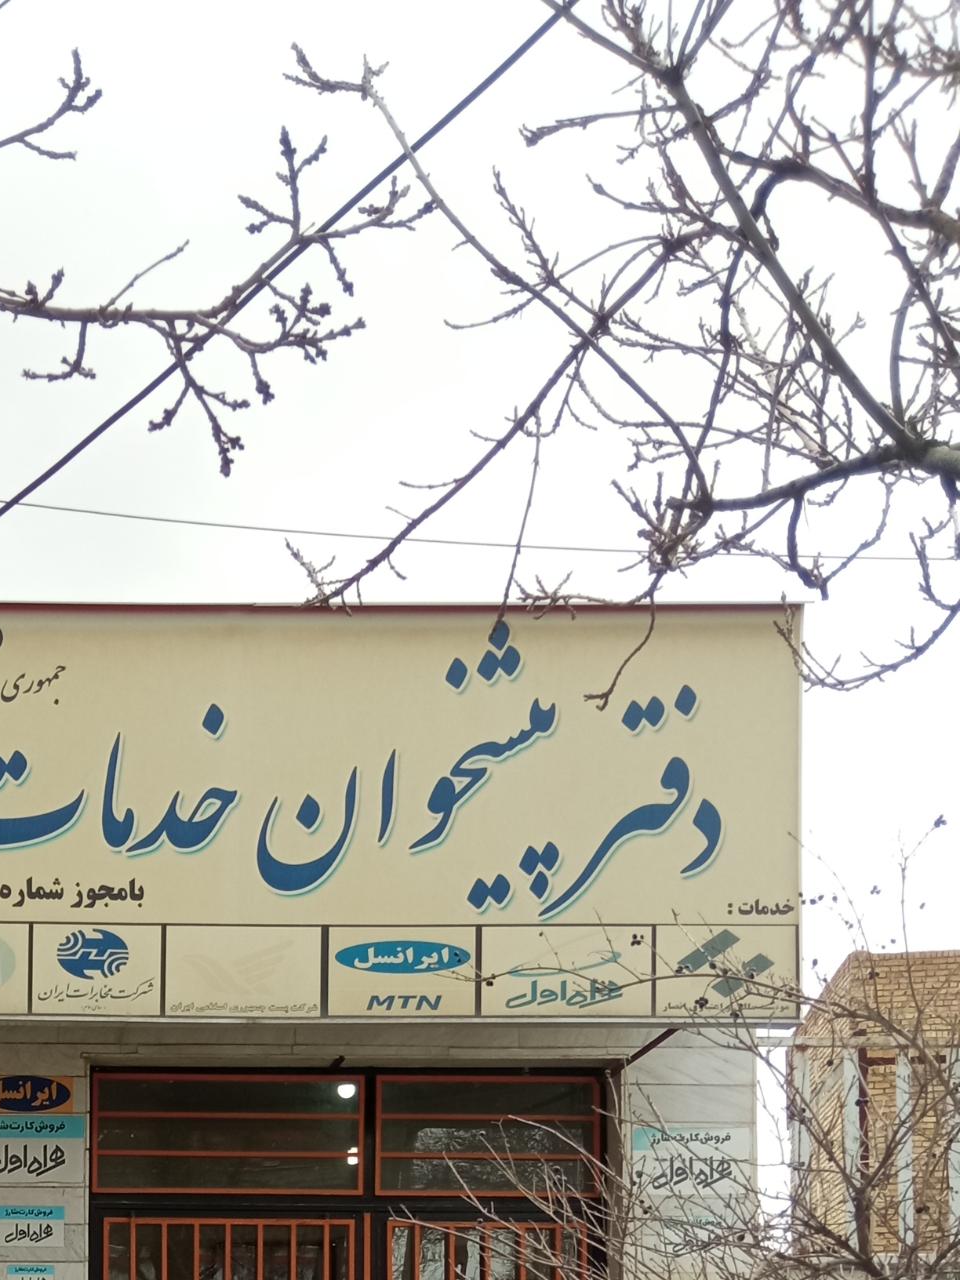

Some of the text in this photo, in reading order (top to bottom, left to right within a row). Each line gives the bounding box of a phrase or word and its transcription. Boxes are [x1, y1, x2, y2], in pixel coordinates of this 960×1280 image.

[0, 665, 66, 705] جمهوری
[256, 622, 561, 913] پیشخوان
[537, 684, 724, 921] دفتر
[737, 899, 795, 916] خدمات
[353, 945, 450, 970] ایرانسل
[37, 976, 155, 1002] شرکت مخابرات ایران
[505, 980, 567, 1009] اول
[365, 995, 442, 1011] MTN
[9, 1120, 35, 1133] کارت
[34, 1120, 66, 1133] فروش
[700, 1132, 731, 1145] فروش
[26, 1143, 66, 1177] همراه
[652, 1156, 694, 1190] اول
[4, 1223, 54, 1243] همراه اول
